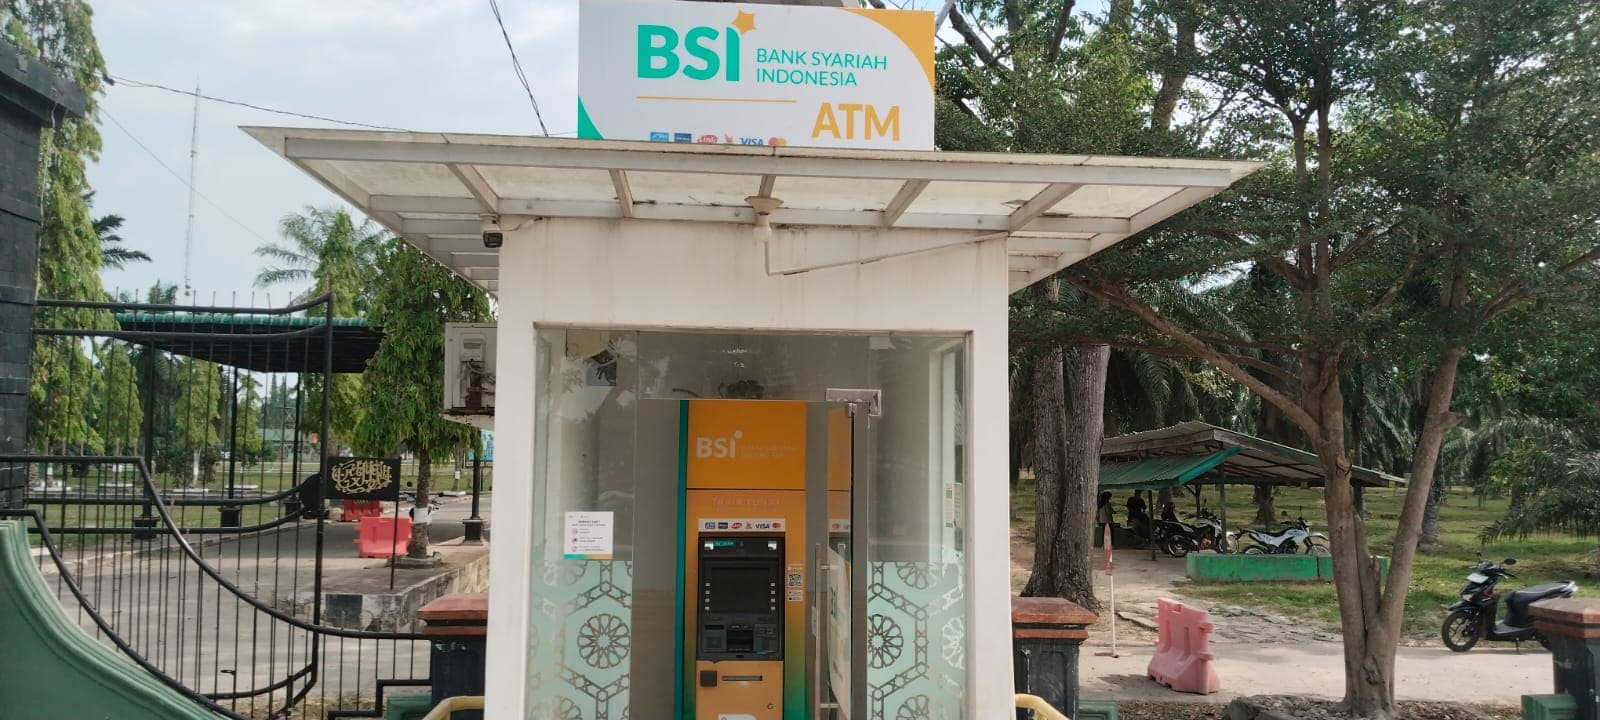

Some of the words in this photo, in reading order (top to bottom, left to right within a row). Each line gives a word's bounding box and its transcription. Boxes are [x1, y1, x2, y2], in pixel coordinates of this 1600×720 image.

[637, 24, 740, 82] BSI
[756, 48, 807, 66] BANK
[811, 51, 888, 71] SYARIAH
[756, 68, 858, 87] INDONESIA
[811, 102, 900, 142] ATM
[740, 137, 764, 146] VISA
[696, 436, 736, 459] BSI
